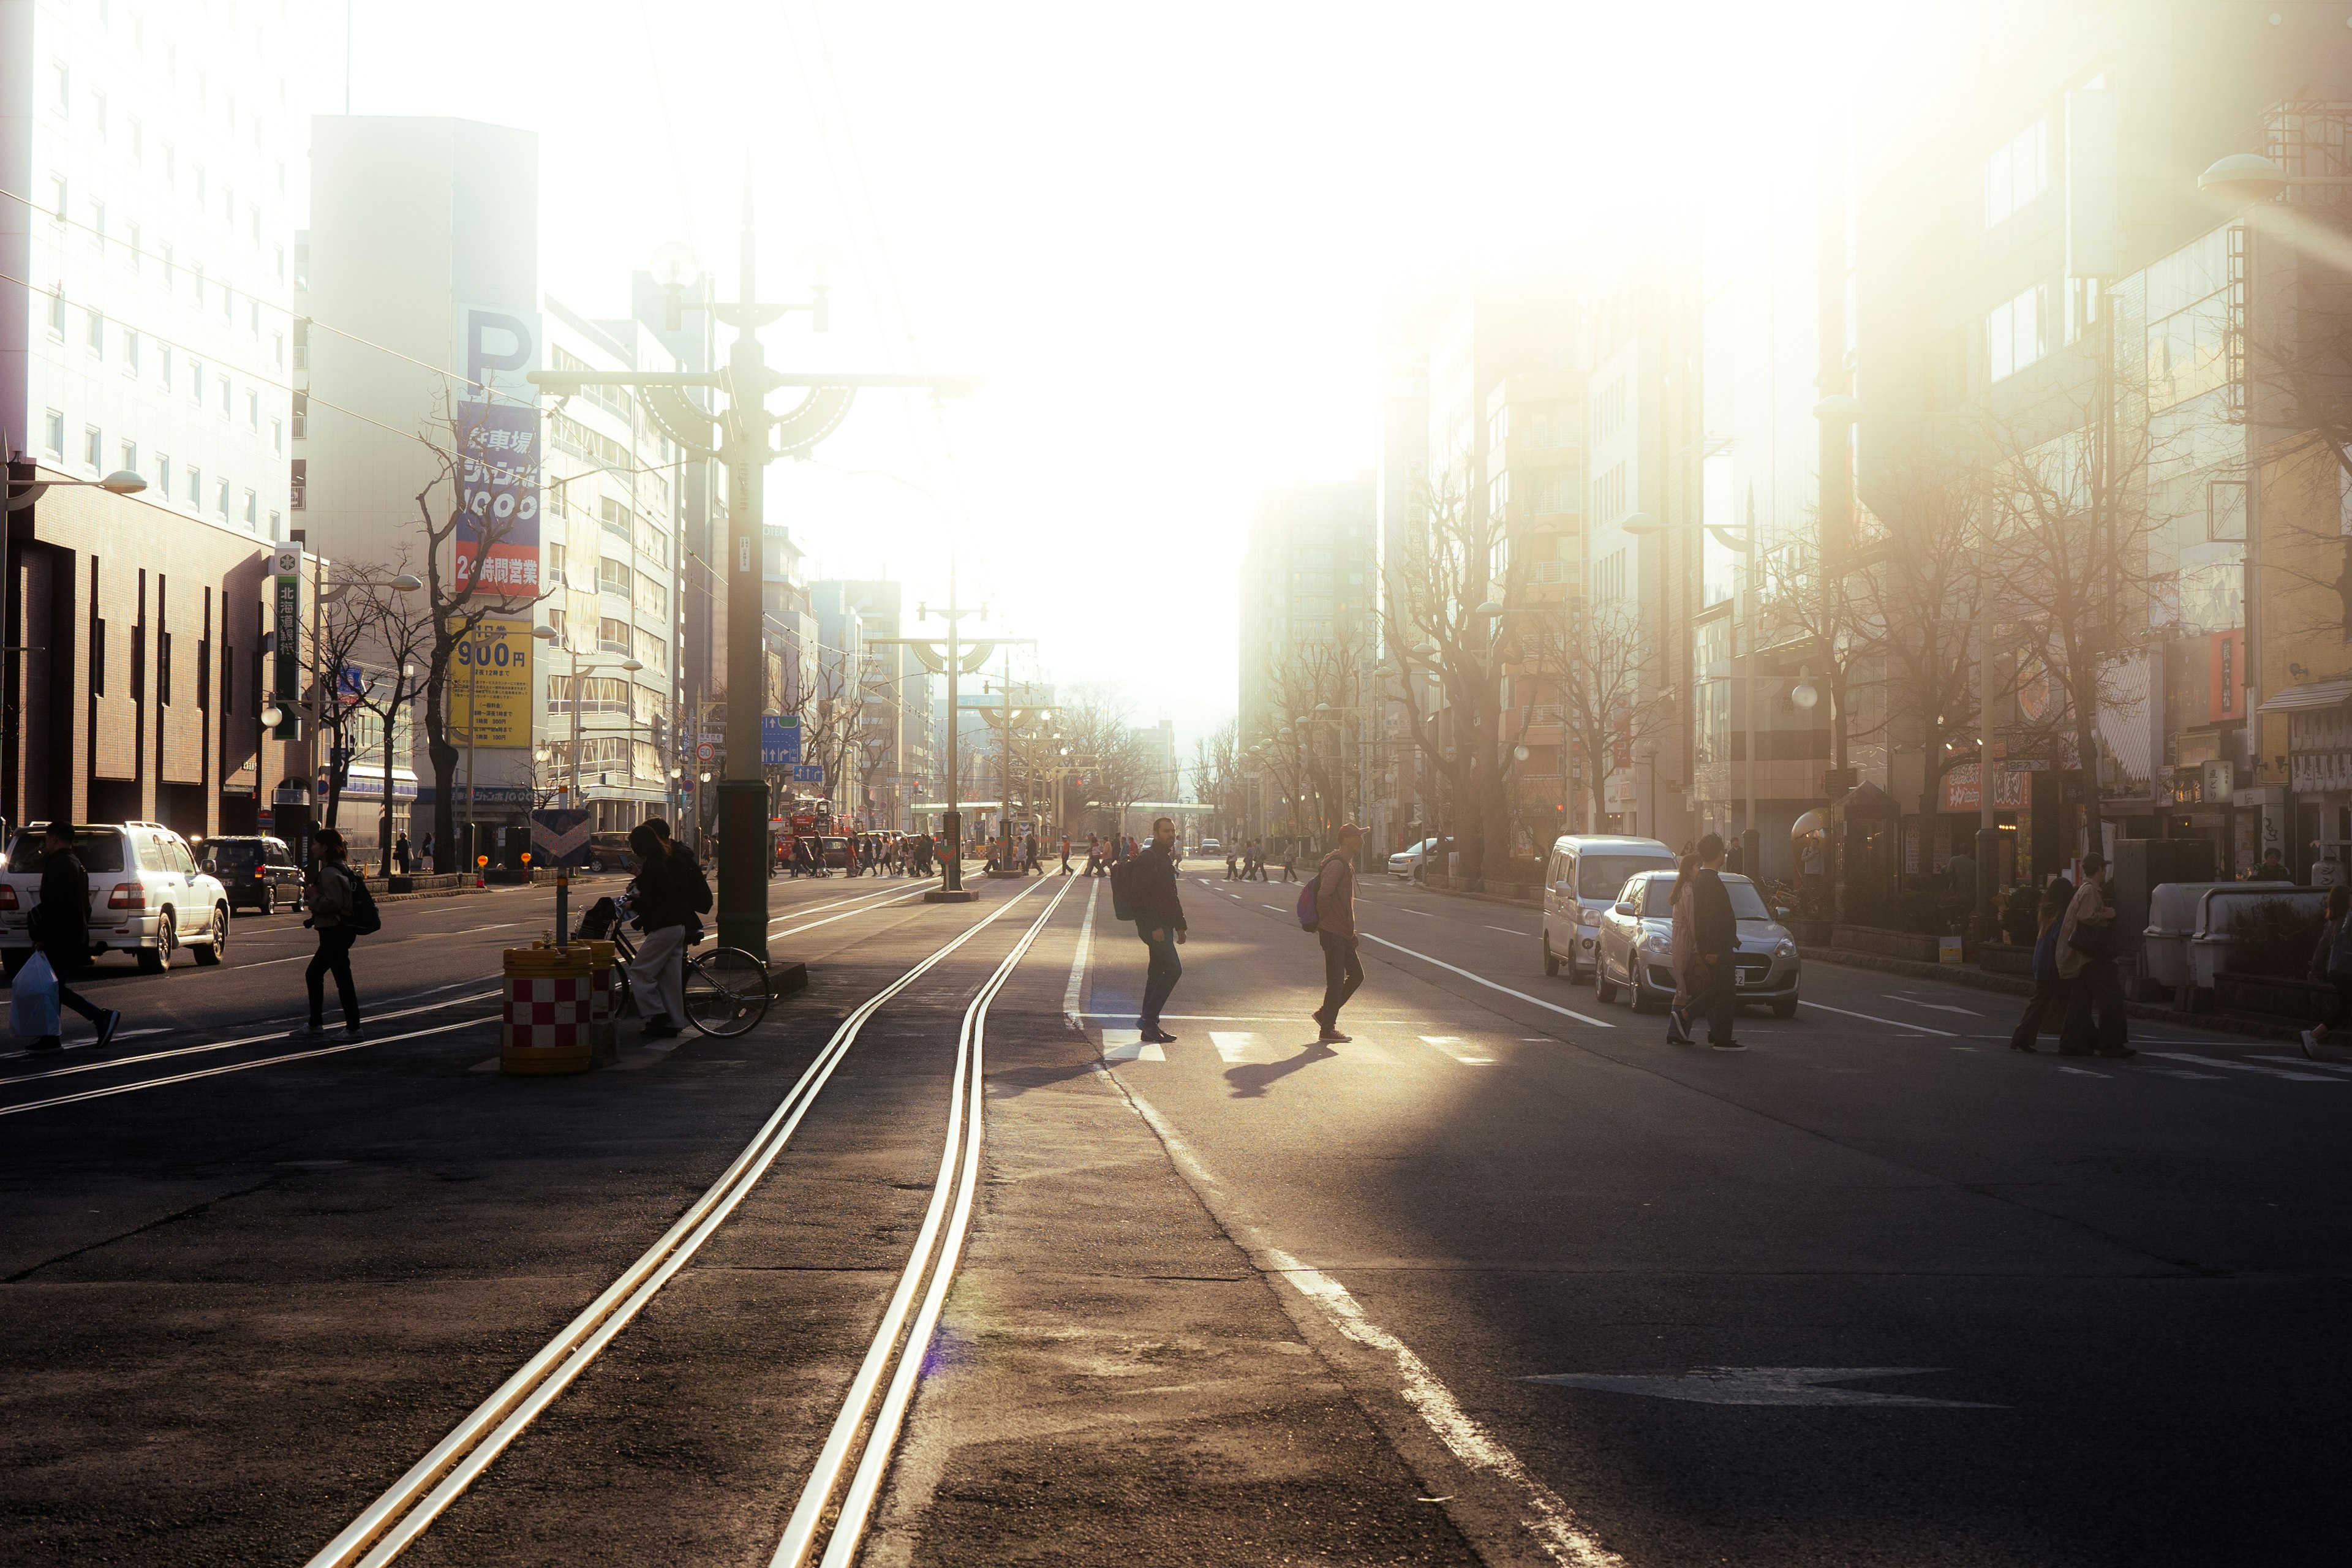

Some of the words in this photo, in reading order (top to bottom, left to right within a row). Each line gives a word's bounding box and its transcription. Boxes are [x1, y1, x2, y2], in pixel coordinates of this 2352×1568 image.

[467, 309, 532, 395] P
[464, 489, 538, 520] 1000
[281, 586, 294, 655] 北海道銀行
[458, 641, 526, 667] 900円
[700, 748, 710, 756] 50
[2209, 769, 2218, 801] 直どり
